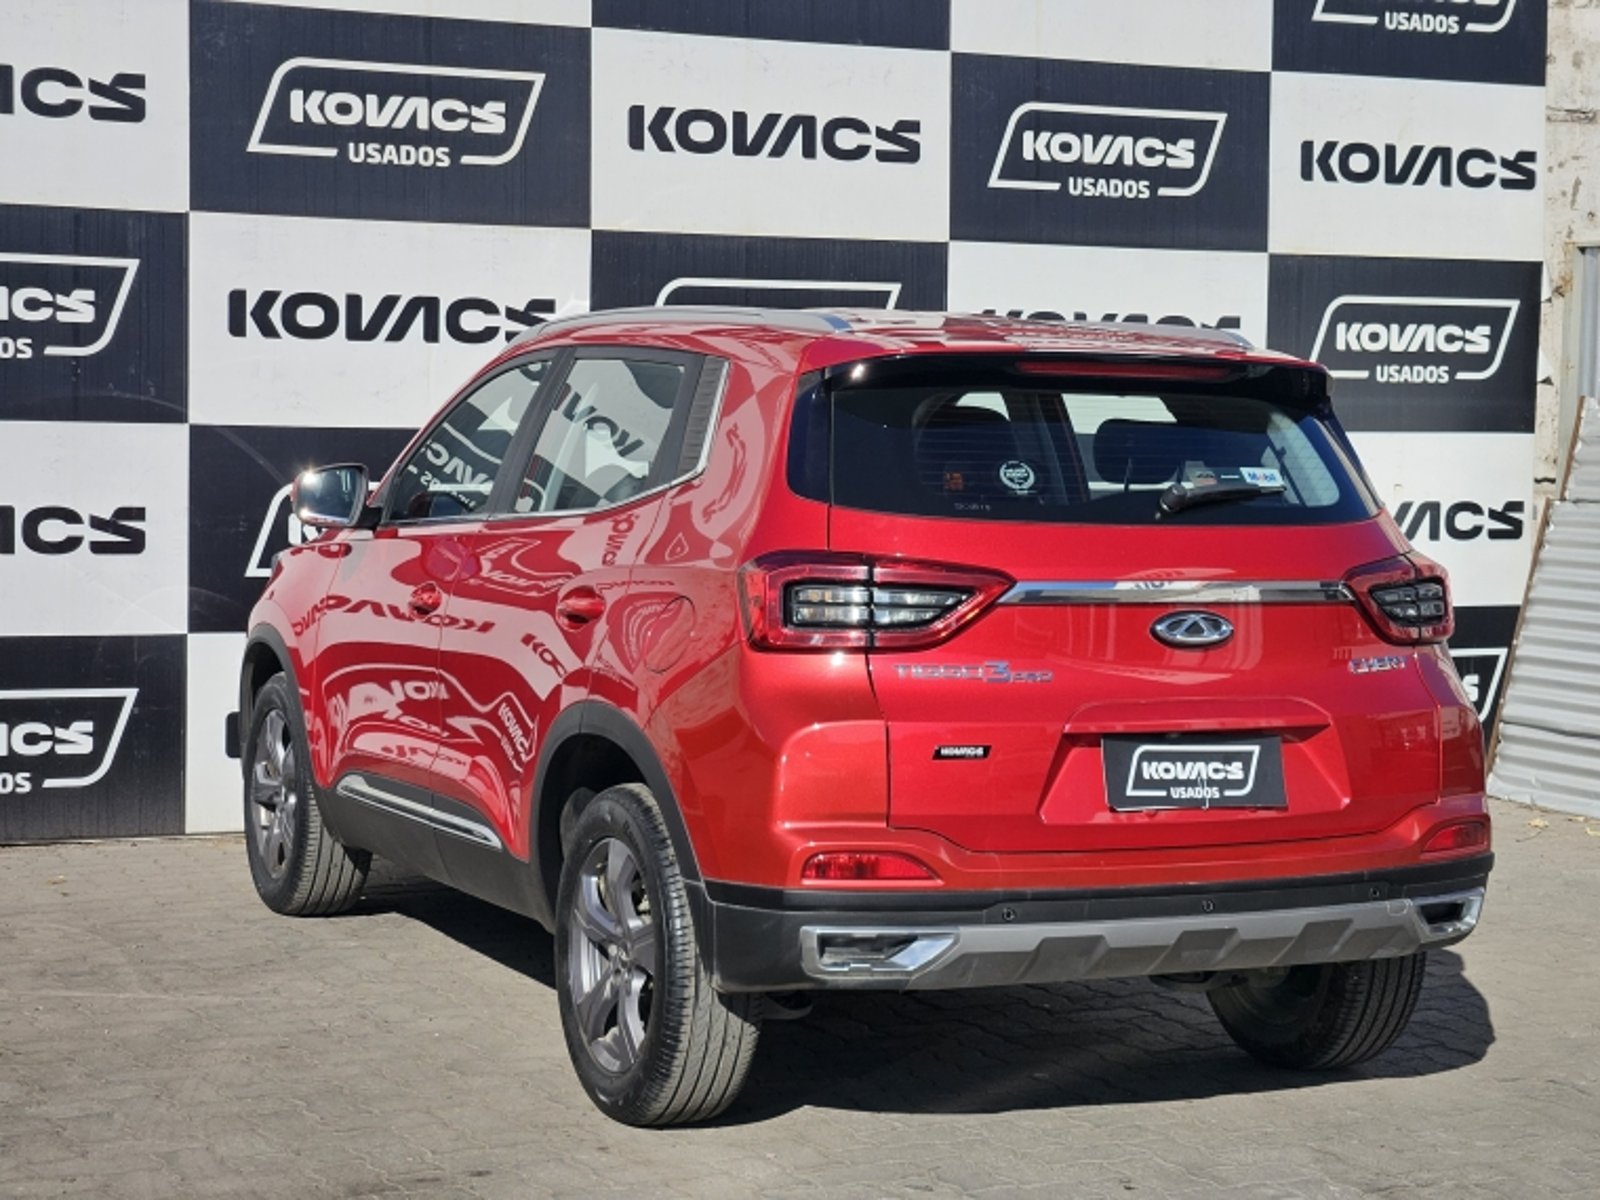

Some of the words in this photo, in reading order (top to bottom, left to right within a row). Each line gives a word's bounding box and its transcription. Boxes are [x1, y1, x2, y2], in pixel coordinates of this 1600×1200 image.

[1384, 11, 1460, 34] USADOS
[289, 89, 506, 134] KOVACS
[628, 104, 921, 164] KOVACS
[348, 142, 451, 168] USADOS
[1022, 129, 1195, 169] KOVACS
[1300, 140, 1537, 190] KOVACS
[1068, 176, 1151, 199] USADOS
[1335, 322, 1491, 354] KOVACS
[1375, 364, 1450, 384] USADOS
[1141, 761, 1245, 780] KOVACS
[1169, 786, 1221, 799] USADOS
